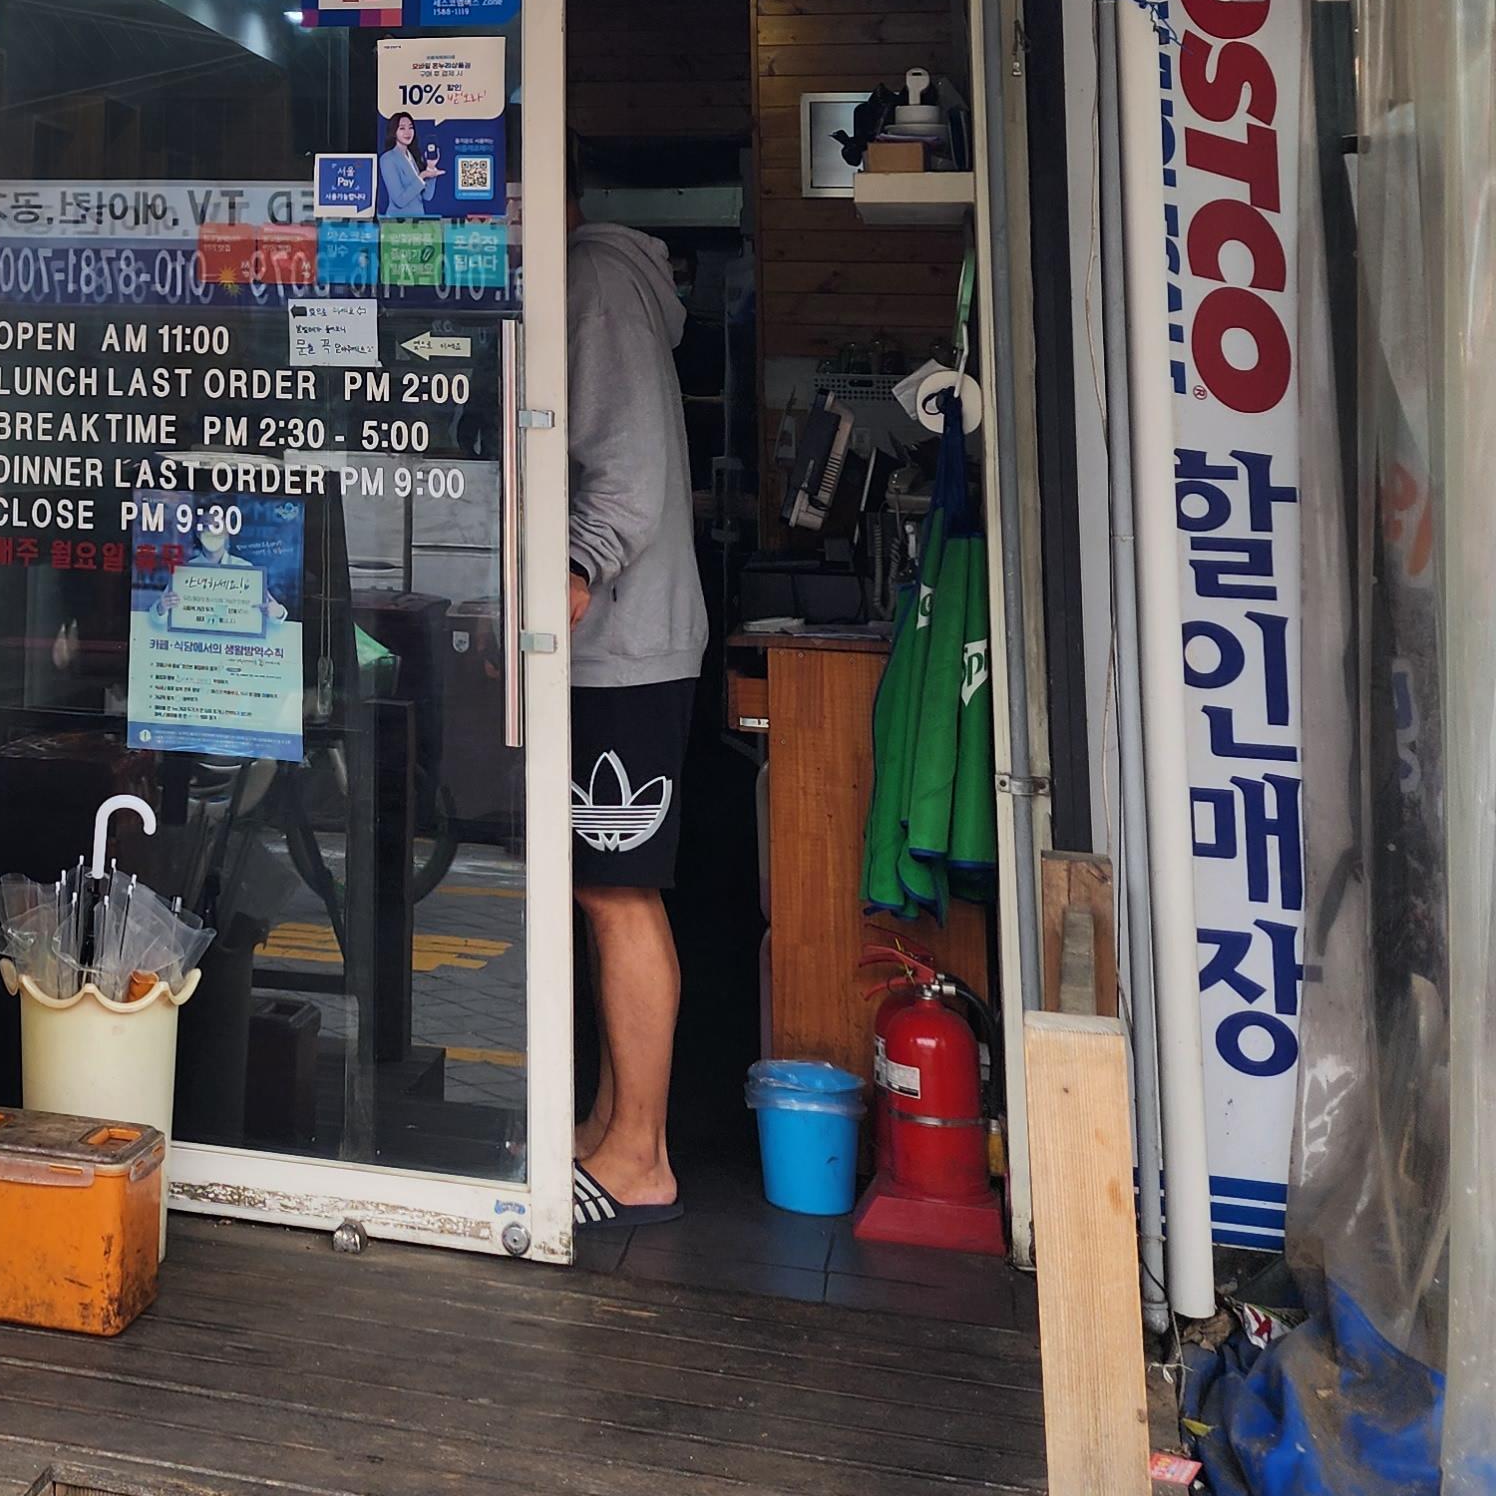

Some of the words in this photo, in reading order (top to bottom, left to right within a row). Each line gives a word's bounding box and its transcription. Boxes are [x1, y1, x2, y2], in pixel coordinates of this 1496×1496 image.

[399, 84, 445, 105] 10%
[337, 166, 355, 177] 서울
[337, 177, 355, 188] Pay
[101, 323, 147, 354] AM
[159, 324, 230, 355] 11:00
[108, 367, 192, 398] LAST
[204, 368, 317, 401] ORDER
[344, 372, 390, 402] PM
[402, 372, 470, 404] 2:00
[204, 416, 248, 447] PM
[259, 418, 325, 450] 2:30
[362, 421, 429, 452] 5:00
[115, 459, 199, 491] LAST
[212, 462, 325, 495] ORDER
[340, 465, 385, 497] PM
[394, 467, 466, 499] 9:00
[120, 502, 164, 533] PM
[176, 504, 243, 535] 9:30
[51, 539, 125, 572] 월요일
[1175, 449, 1302, 1077] 할인매장
